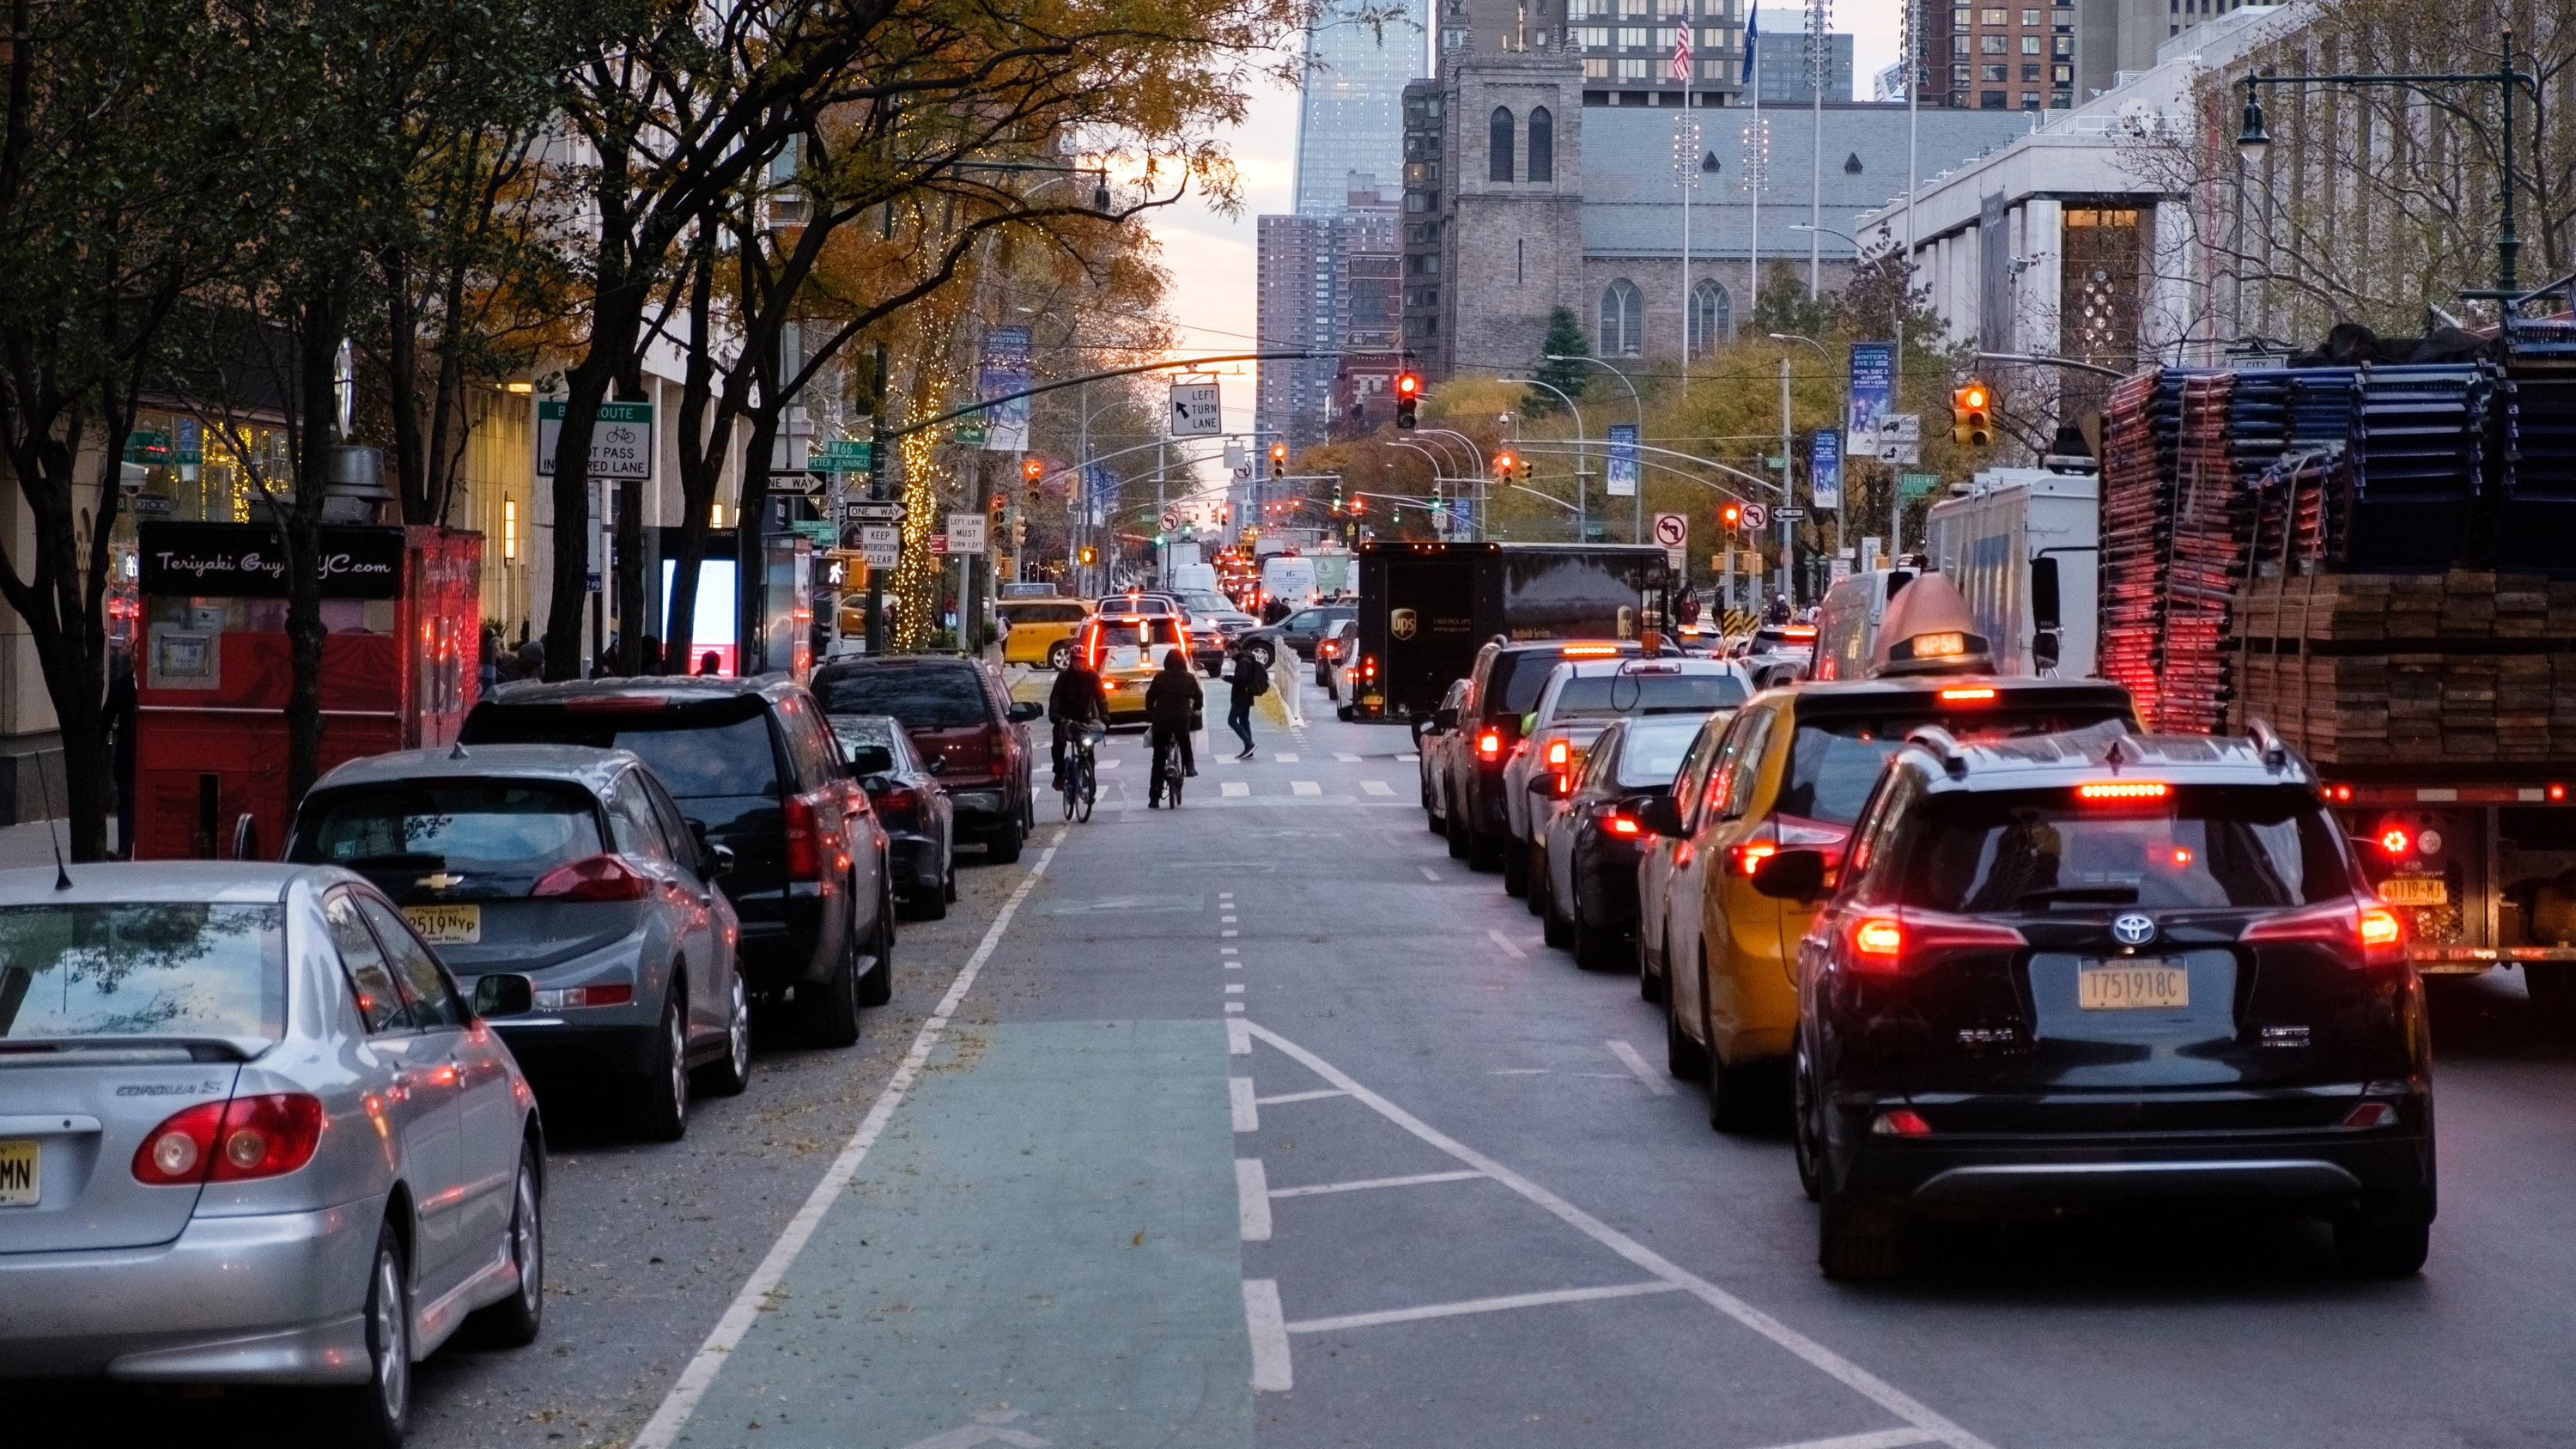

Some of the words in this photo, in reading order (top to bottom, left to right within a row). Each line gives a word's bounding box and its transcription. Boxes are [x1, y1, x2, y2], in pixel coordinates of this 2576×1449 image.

[1192, 390, 1215, 401] LEFT
[597, 406, 635, 420] OUTE
[1192, 404, 1218, 415] TURN
[1193, 417, 1217, 429] LANE
[603, 447, 635, 460] PASS
[612, 462, 646, 473] LANE
[809, 458, 832, 467] PETER
[834, 459, 869, 468] JENNINGS
[768, 478, 782, 489] NE
[792, 478, 815, 489] WAY
[851, 507, 870, 516] ONE
[880, 508, 901, 516] WAY
[871, 531, 890, 540] KEEP
[956, 529, 976, 538] MUST
[863, 543, 897, 552] INTERSECTION
[155, 551, 236, 578] Teriyaki
[867, 555, 893, 564] CLEAR
[1393, 618, 1415, 636] ups
[1534, 628, 1551, 638] Services
[1919, 636, 1961, 654] 4P54
[2090, 971, 2178, 1000] T751918C
[115, 1083, 197, 1097] COROLLA
[197, 1079, 225, 1095] S
